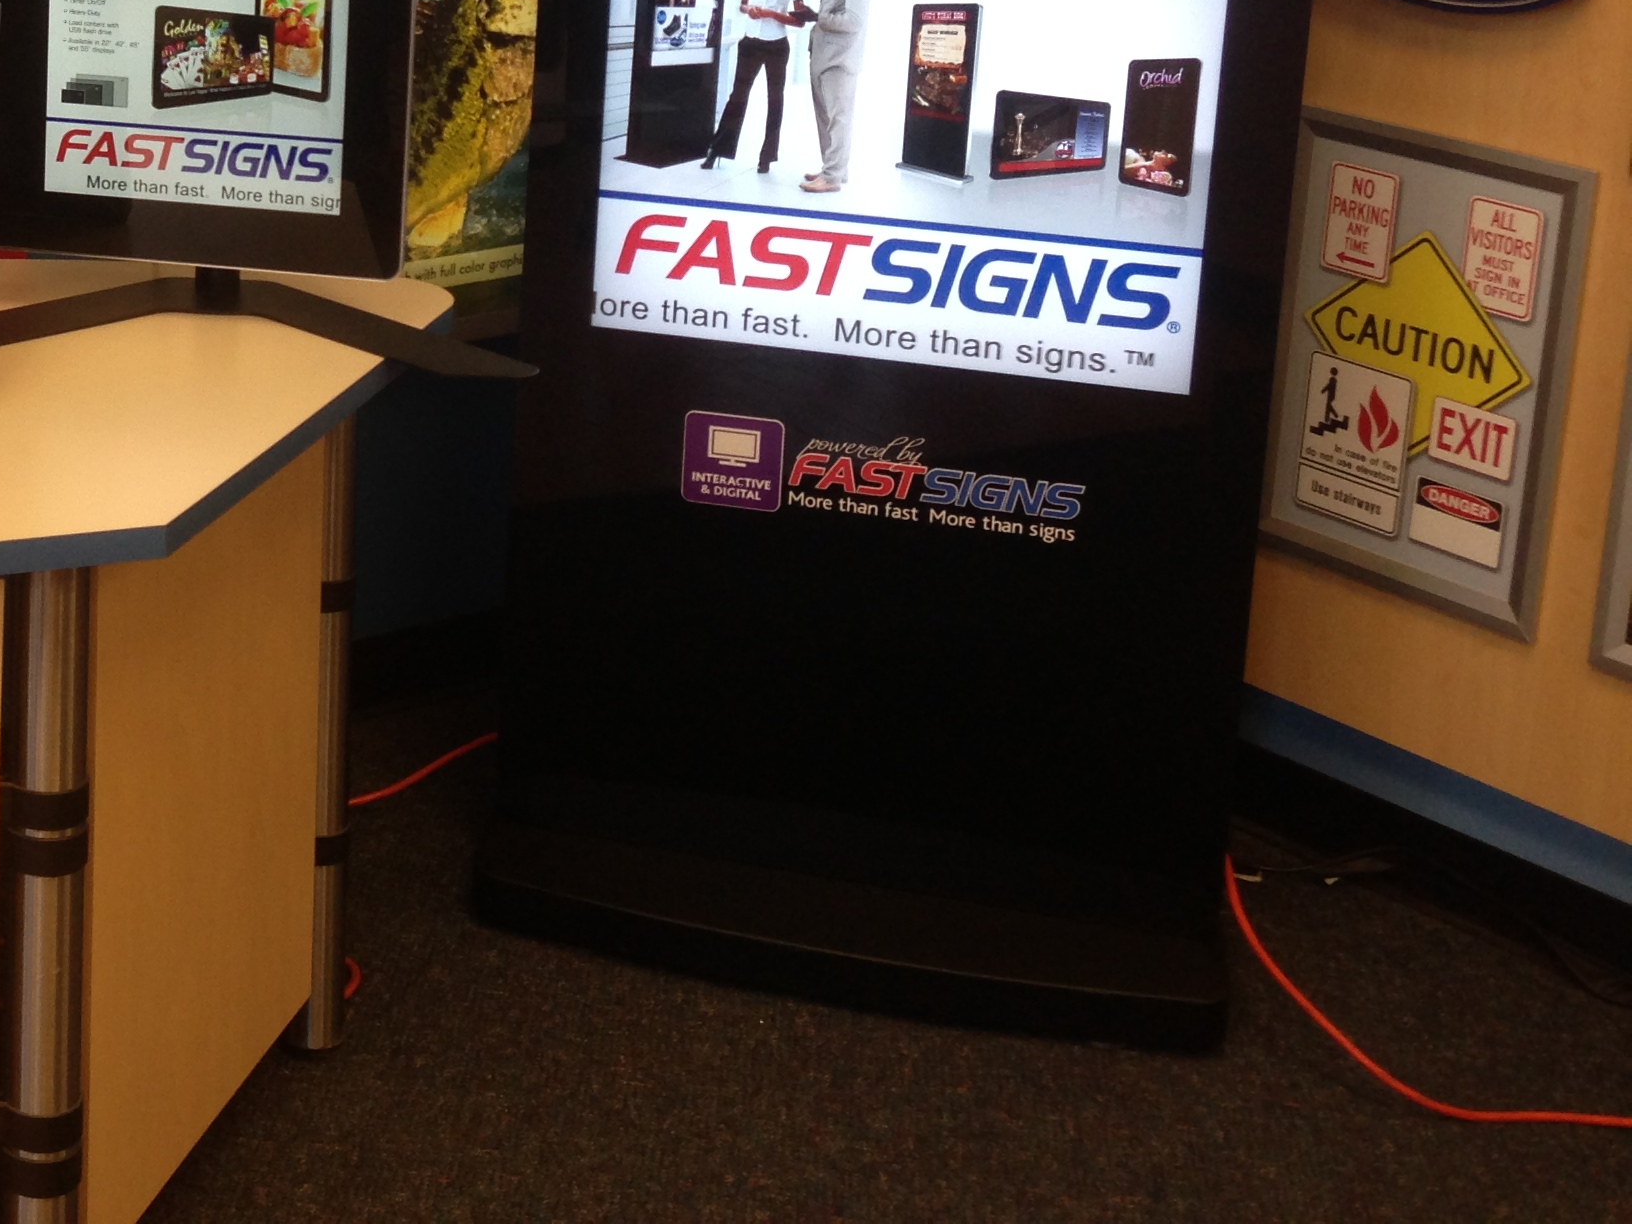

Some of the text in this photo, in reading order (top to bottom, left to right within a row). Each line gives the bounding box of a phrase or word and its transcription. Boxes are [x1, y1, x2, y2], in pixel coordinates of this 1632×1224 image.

[163, 18, 204, 38] Golden
[55, 128, 334, 183] FASTSIGNS
[86, 174, 128, 192] More
[133, 178, 169, 195] than
[221, 185, 263, 203] More
[269, 189, 305, 207] than
[1351, 176, 1375, 200] NO
[1331, 195, 1390, 228] PARKING
[1490, 208, 1517, 233] ALL
[1347, 221, 1370, 237] ANY
[1471, 227, 1534, 261] VISITORS
[1344, 236, 1369, 256] TIME
[614, 212, 1183, 332] FASTSIGNS
[1474, 266, 1521, 289] SIGN IN
[1481, 254, 1516, 273] MUST
[1483, 283, 1527, 306] OFFICE
[593, 290, 650, 322] ore
[661, 299, 730, 331] than
[741, 306, 809, 339] fast.
[834, 316, 917, 352] More
[929, 329, 1002, 362] than
[1334, 305, 1496, 384] CAUTION
[797, 437, 926, 470] powered by
[1436, 407, 1510, 470] EXIT
[691, 471, 772, 492] INTERACTIVE
[700, 485, 762, 501] & DIGITAL
[786, 452, 1086, 521] FASTSIGNS
[1311, 479, 1382, 517] Use stairways
[788, 489, 1076, 544] More than fast More than signs
[1428, 487, 1492, 521] DANGER
